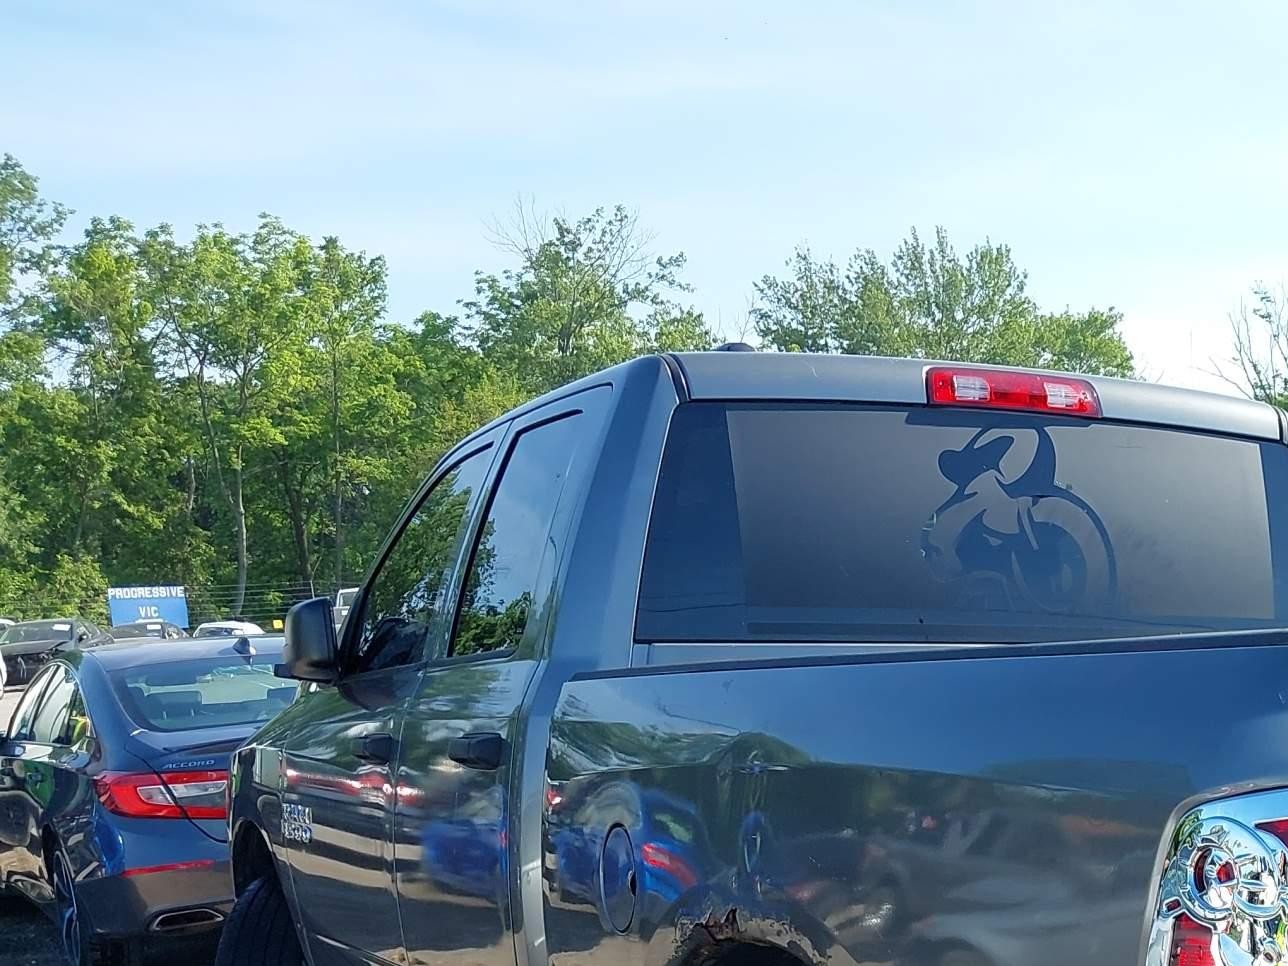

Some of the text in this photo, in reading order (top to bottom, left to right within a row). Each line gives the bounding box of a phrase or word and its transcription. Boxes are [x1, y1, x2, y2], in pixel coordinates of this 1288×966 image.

[108, 586, 185, 599] PROGRESSIVE
[138, 606, 160, 618] VIC
[163, 759, 216, 770] ACCORD
